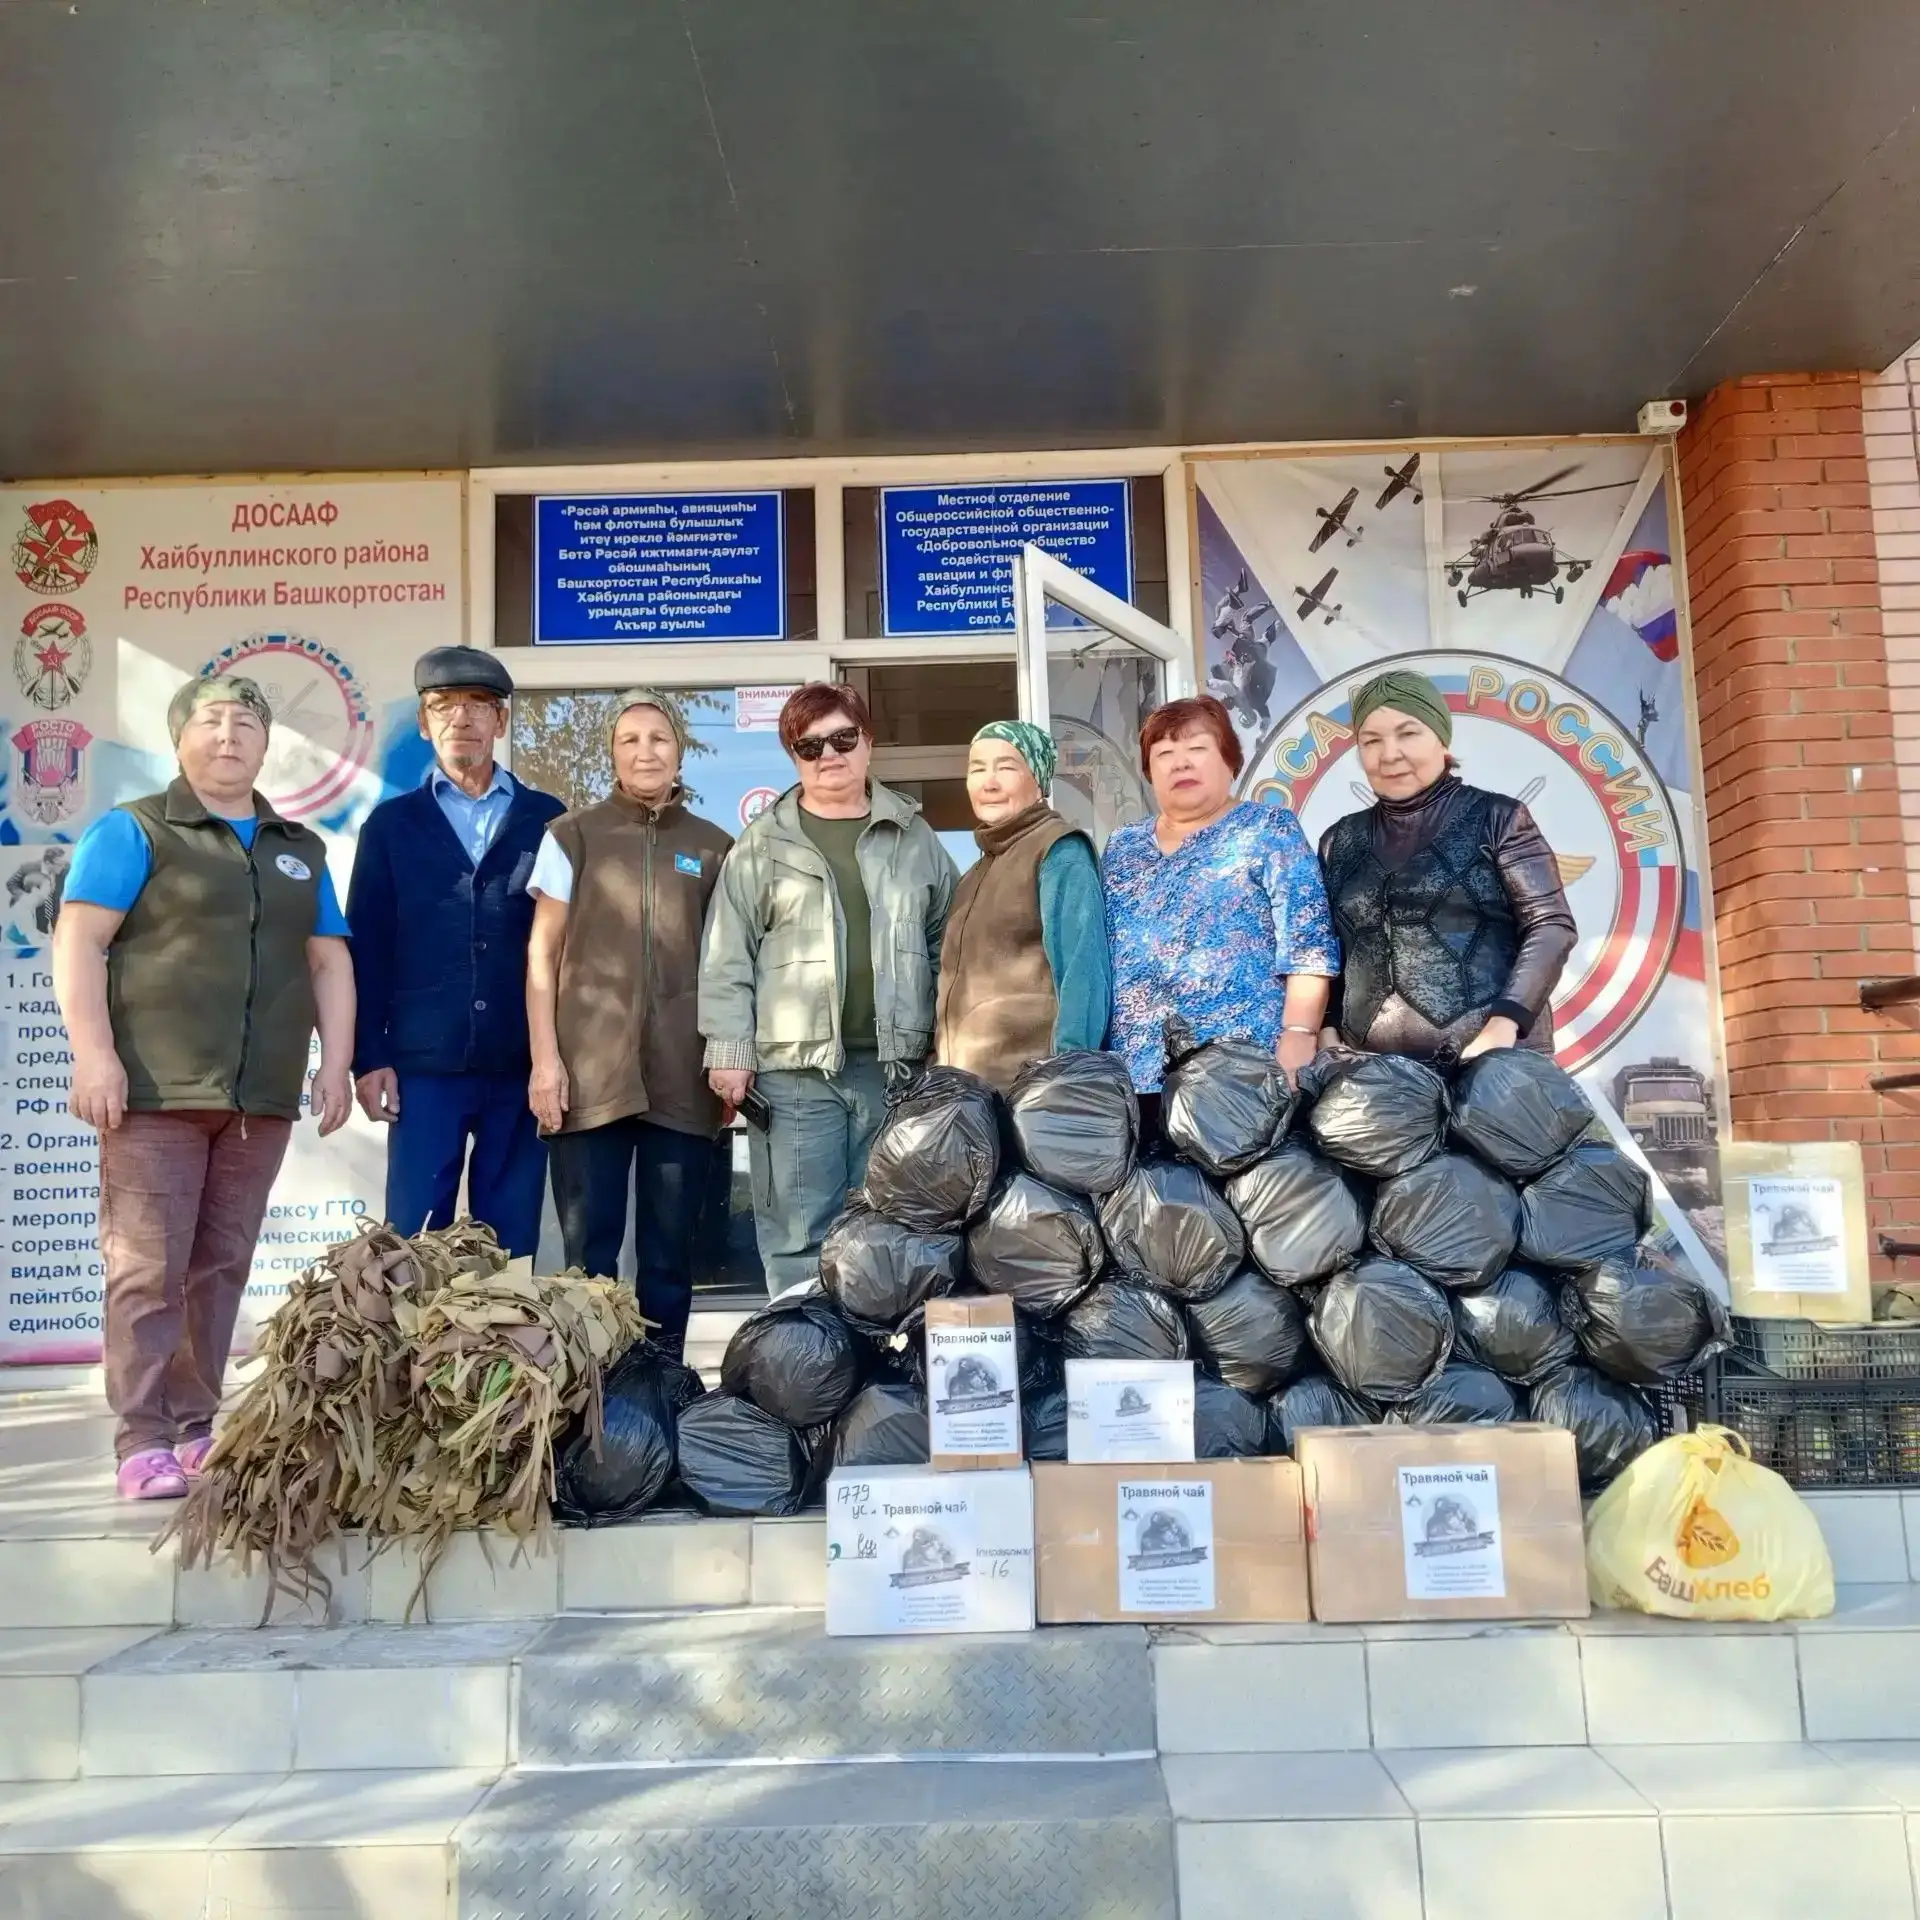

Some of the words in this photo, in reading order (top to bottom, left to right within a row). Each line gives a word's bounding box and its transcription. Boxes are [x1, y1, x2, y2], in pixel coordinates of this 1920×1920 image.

[937, 494, 996, 506] Местное
[999, 492, 1071, 504] отделение
[681, 502, 757, 514] авияцияһы
[895, 506, 1014, 524] Общероссийской
[1018, 505, 1115, 519] общественно-
[231, 501, 339, 532] ДОСААФ
[604, 519, 667, 532] флотына
[901, 521, 1018, 539] государственной
[1022, 520, 1109, 535] организации
[916, 538, 1025, 553] «Добровольное
[1029, 535, 1097, 548] общество
[139, 543, 337, 574] Хайбуллинского
[344, 539, 430, 570] района
[661, 574, 762, 588] Республикаһы
[917, 570, 976, 582] авиации
[979, 570, 988, 579] и
[123, 583, 267, 614] Республики
[273, 581, 446, 609] Башкортостан
[924, 583, 1015, 598] Хайбуллинск
[916, 598, 998, 613] Республики
[659, 620, 705, 632] ауылы
[968, 615, 1002, 625] село
[737, 690, 793, 699] ВНИМАНИ
[1466, 665, 1670, 853] РОССИИ
[16, 1098, 50, 1115] РФ
[13, 1186, 99, 1201] воспита
[326, 1199, 366, 1215] ГТО
[13, 1212, 96, 1228] меропр
[11, 1263, 81, 1280] видам
[930, 1332, 988, 1346] Травяной
[990, 1331, 1012, 1344] чай
[1402, 1470, 1463, 1486] Травяной
[1466, 1469, 1488, 1482] чай
[1121, 1485, 1180, 1500] Травяной
[1183, 1485, 1205, 1498] чай
[883, 1502, 942, 1518] Травяной
[945, 1501, 968, 1513] чай
